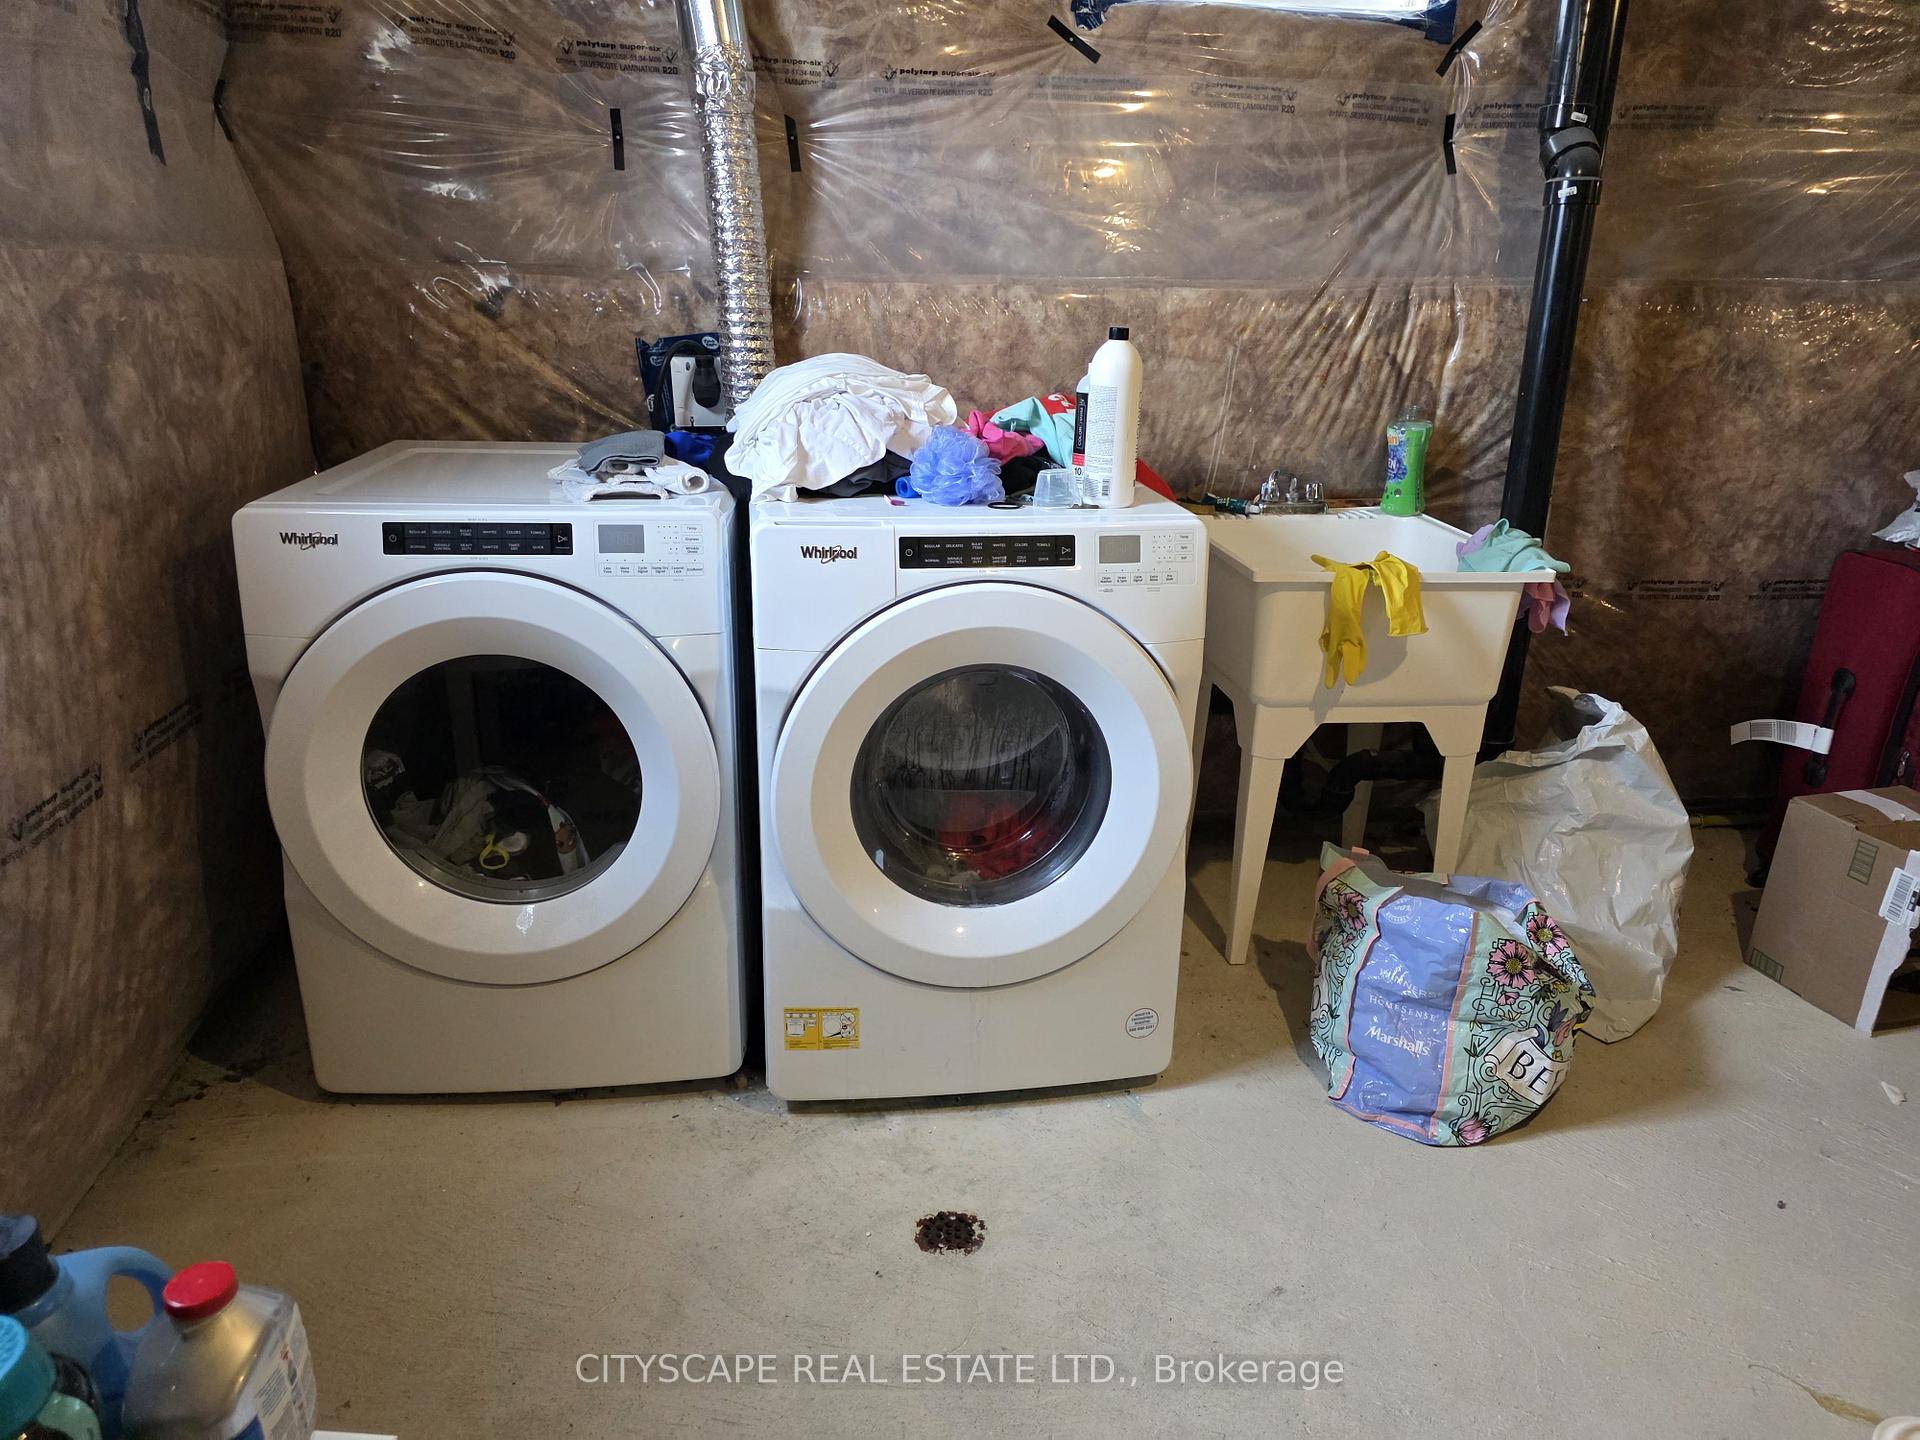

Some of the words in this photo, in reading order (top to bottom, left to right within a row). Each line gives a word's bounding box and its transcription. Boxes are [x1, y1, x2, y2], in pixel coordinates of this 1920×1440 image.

[324, 27, 342, 38] R20
[576, 40, 617, 50] polytarp
[619, 42, 662, 52] super-six
[499, 49, 516, 60] R20
[782, 57, 822, 66] super-six
[620, 62, 660, 74] LAMINATION
[662, 65, 679, 75] R20
[899, 67, 939, 78] polytarp
[1281, 104, 1296, 114] R20
[279, 531, 339, 551] Whirlpool
[800, 545, 858, 563] Whirlpool
[1368, 993, 1440, 1023] HOMESENSE
[1363, 1024, 1432, 1058] Marshalls
